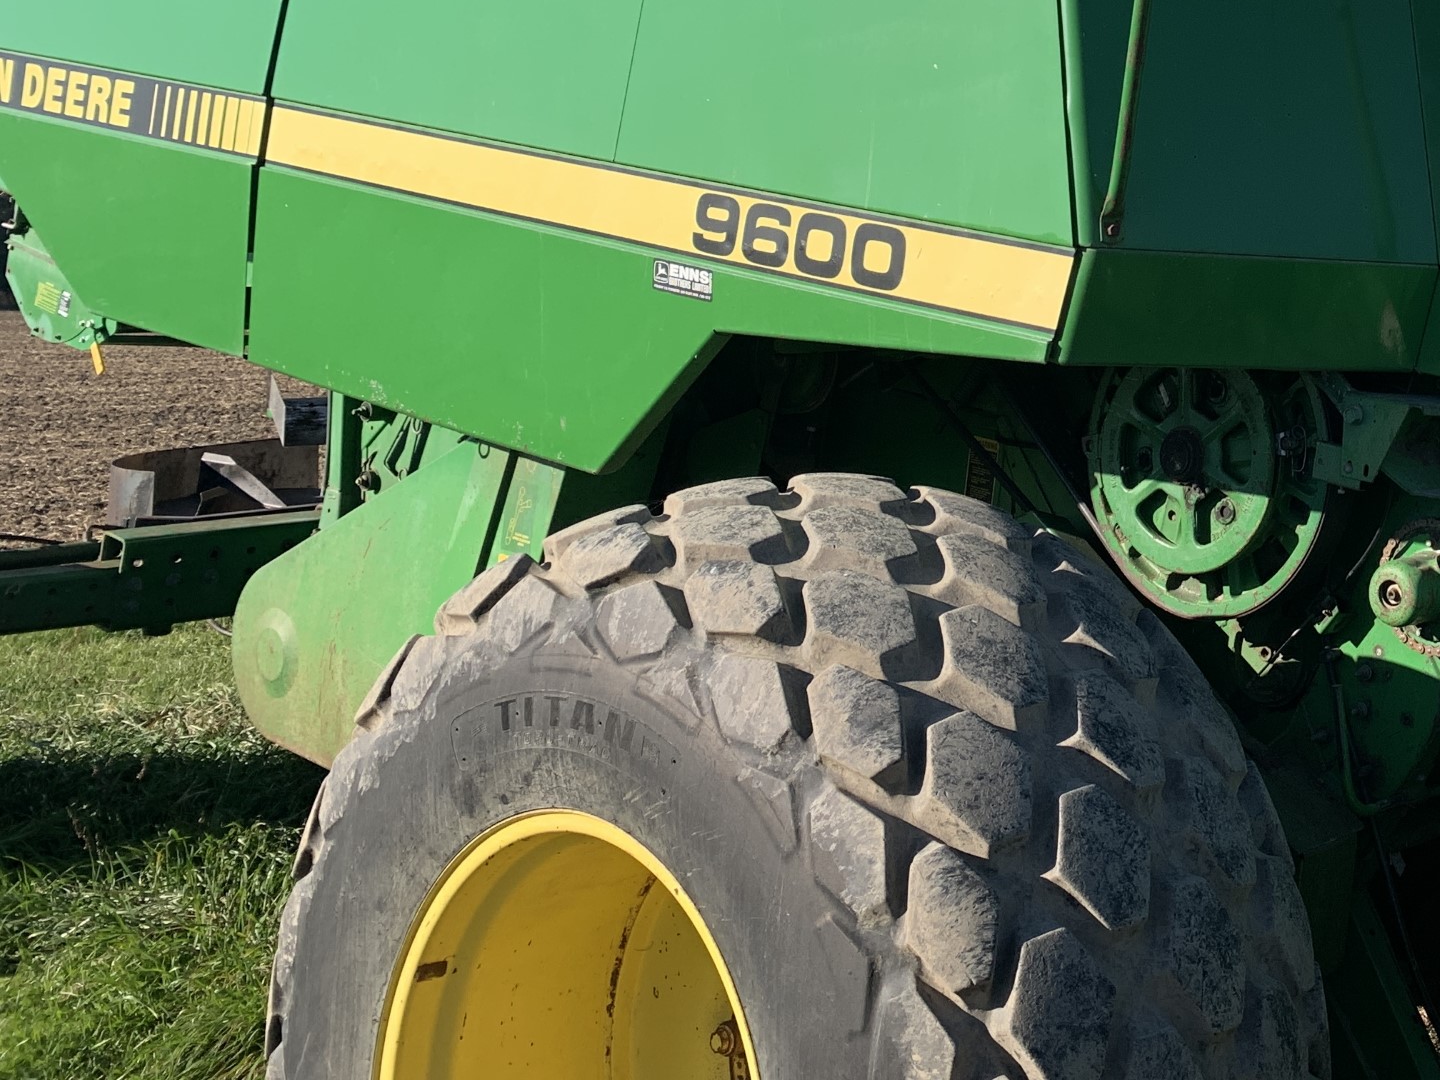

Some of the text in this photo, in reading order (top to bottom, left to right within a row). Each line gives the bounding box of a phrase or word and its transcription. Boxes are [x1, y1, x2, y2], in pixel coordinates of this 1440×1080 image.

[20, 62, 136, 128] DEERE
[691, 192, 907, 291] 9600
[668, 263, 709, 285] ENNS
[493, 695, 637, 752] TITAN
